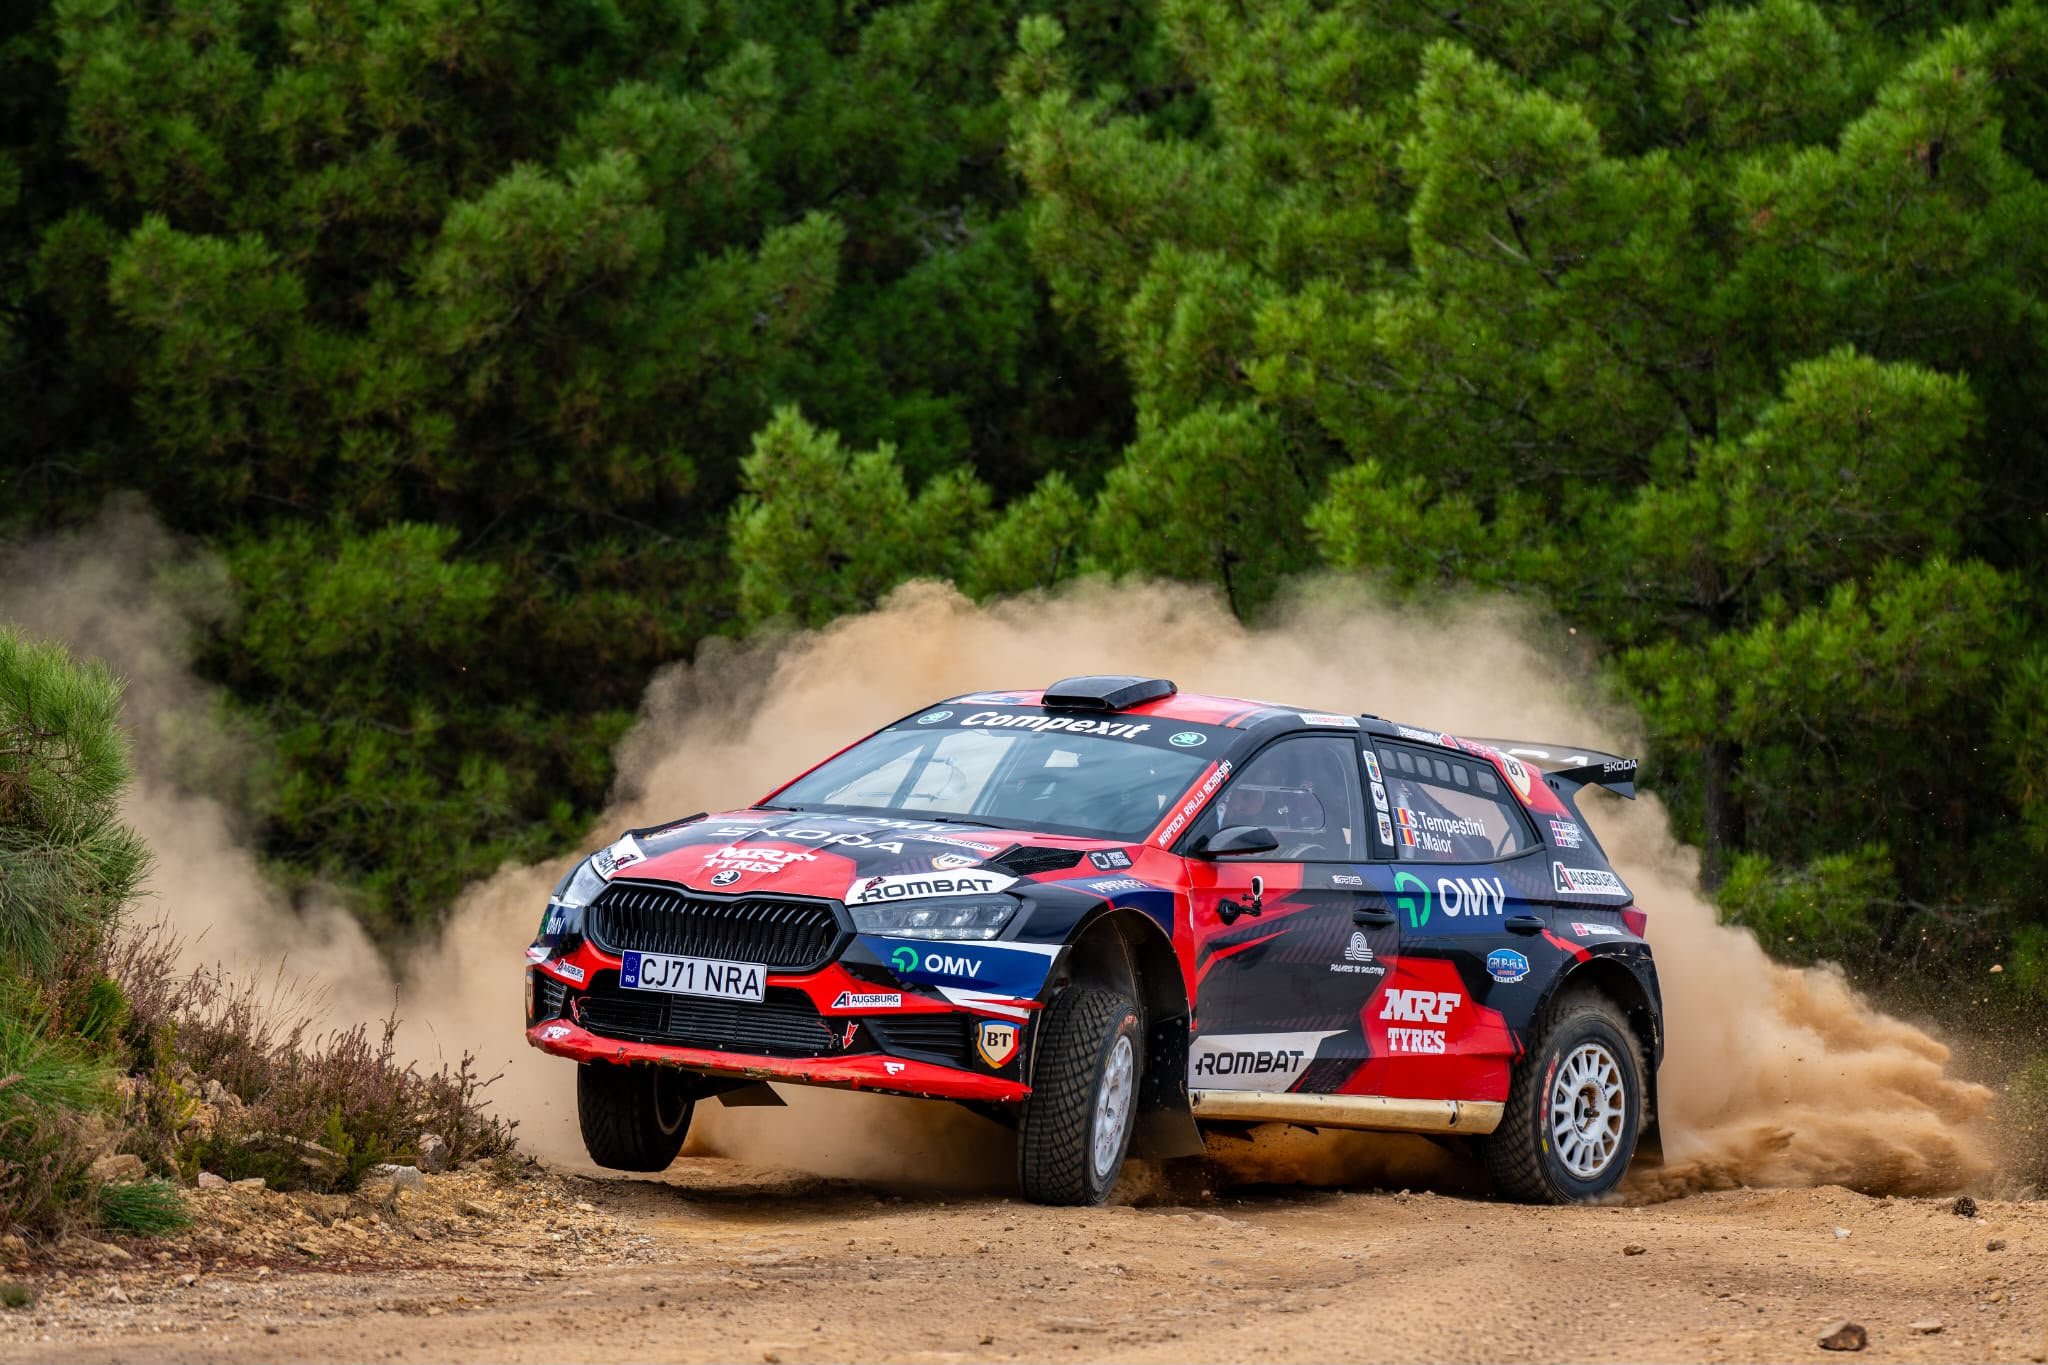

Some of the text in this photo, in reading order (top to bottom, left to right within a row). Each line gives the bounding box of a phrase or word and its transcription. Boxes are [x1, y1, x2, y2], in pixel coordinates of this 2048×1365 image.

[1158, 760, 1233, 847] NAPOCA RALLY ACADEMY
[1408, 809, 1486, 837] S.Tempestini
[1414, 831, 1453, 853] F.Maior
[857, 878, 993, 903] ROMBAT
[1569, 871, 1619, 887] AUGSBURG
[1437, 877, 1506, 917] OMV
[546, 917, 566, 935] OMV
[641, 958, 760, 996] CJ71 NRA
[924, 954, 982, 978] OMV
[625, 974, 636, 983] RO
[851, 995, 899, 1003] AUGSBURG
[1379, 988, 1462, 1024] MRF
[987, 1031, 1011, 1047] BT
[1387, 1028, 1446, 1054] TYRES
[1195, 1051, 1304, 1075] ROMBAT
